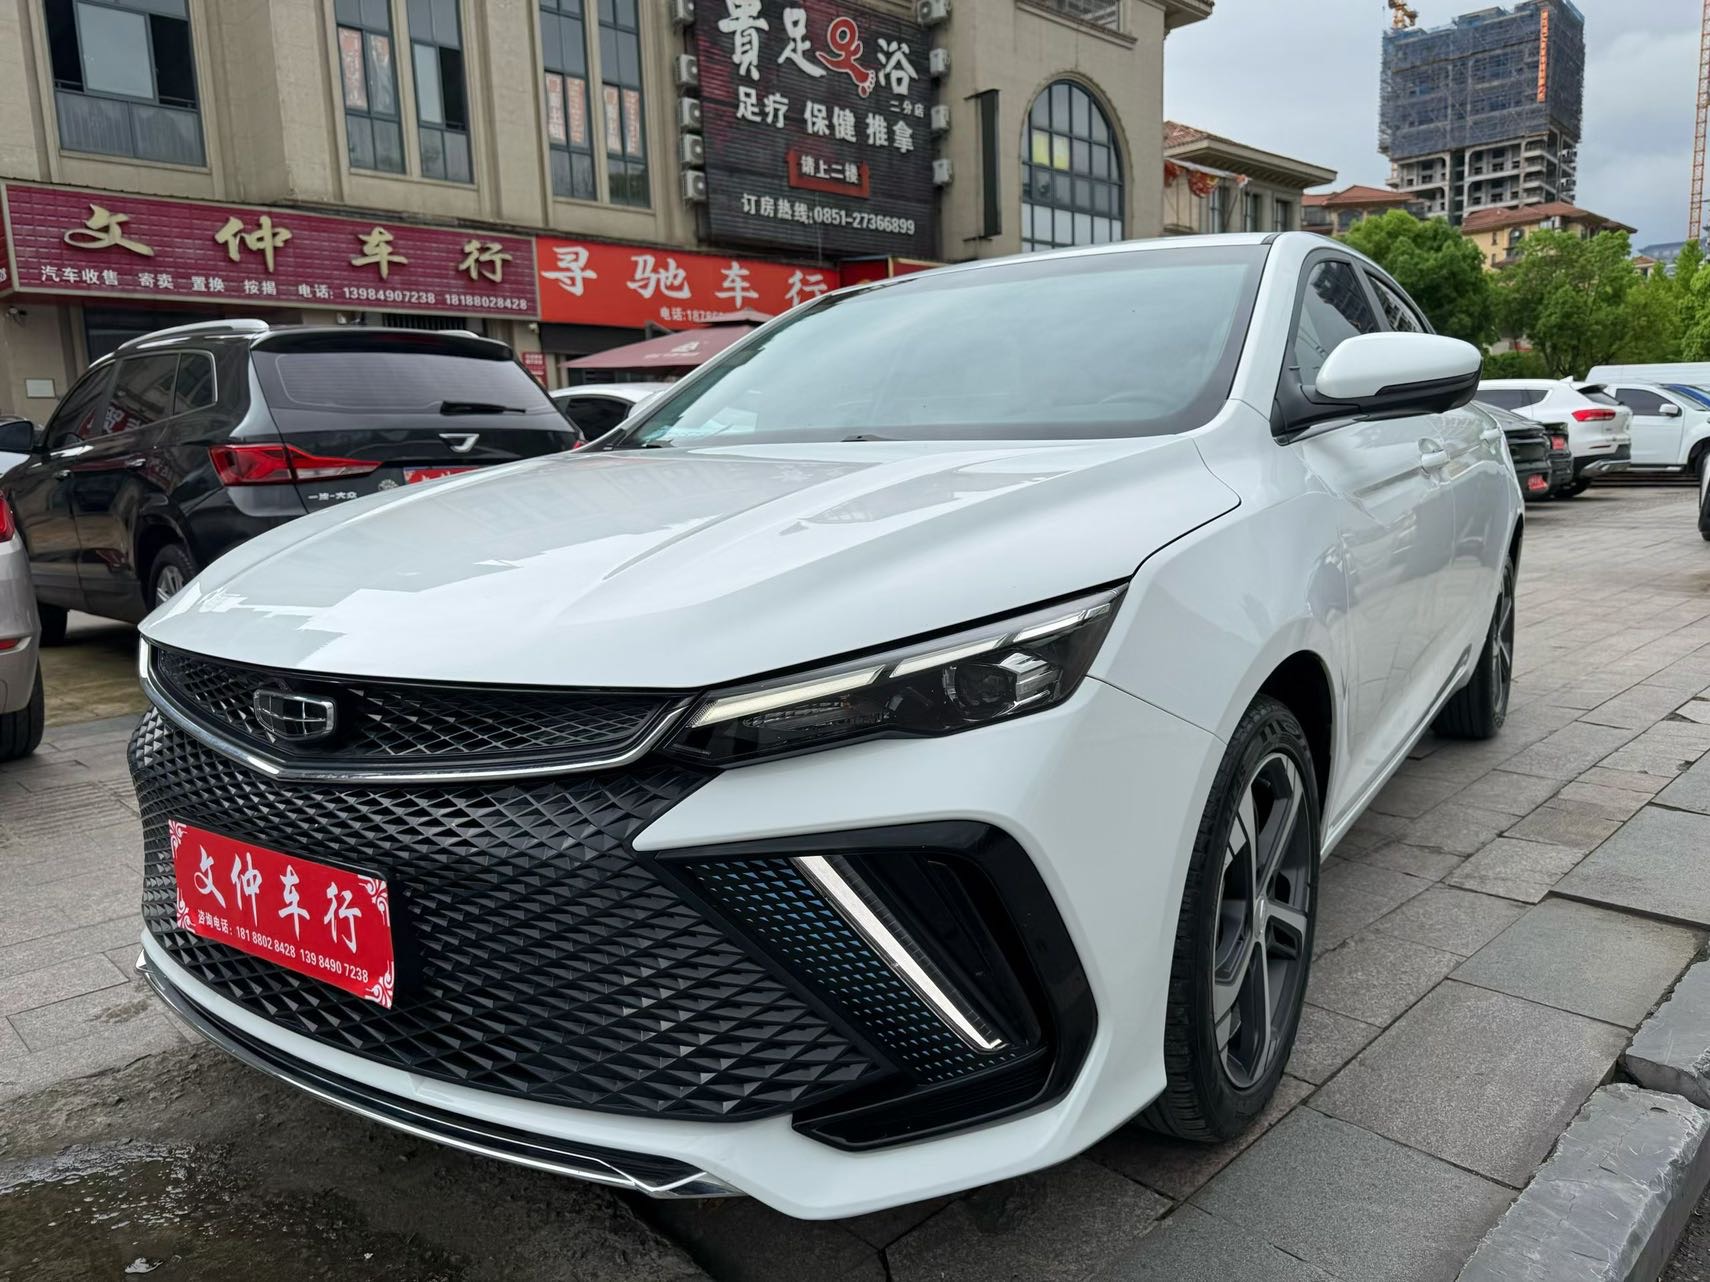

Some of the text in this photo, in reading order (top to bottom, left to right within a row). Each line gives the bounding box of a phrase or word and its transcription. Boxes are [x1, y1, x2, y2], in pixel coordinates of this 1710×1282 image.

[736, 85, 914, 153] 足疗 保健 推拿
[801, 154, 858, 184] 请上二楼
[64, 203, 512, 283] 文仲车行
[41, 265, 118, 286] 汽车收售
[138, 272, 174, 289] 寄卖
[191, 275, 225, 292] 置换
[244, 279, 277, 295] 按揭
[343, 287, 436, 304] 13984907238
[445, 293, 528, 310] 18188028428
[541, 246, 827, 308] 寻驰车行
[193, 844, 362, 954] 文仲车行
[236, 926, 250, 942] 181
[252, 931, 273, 950] 8802
[274, 939, 296, 958] 8428
[300, 948, 317, 966] 139
[318, 955, 342, 974] 8490
[343, 962, 369, 983] 7238
